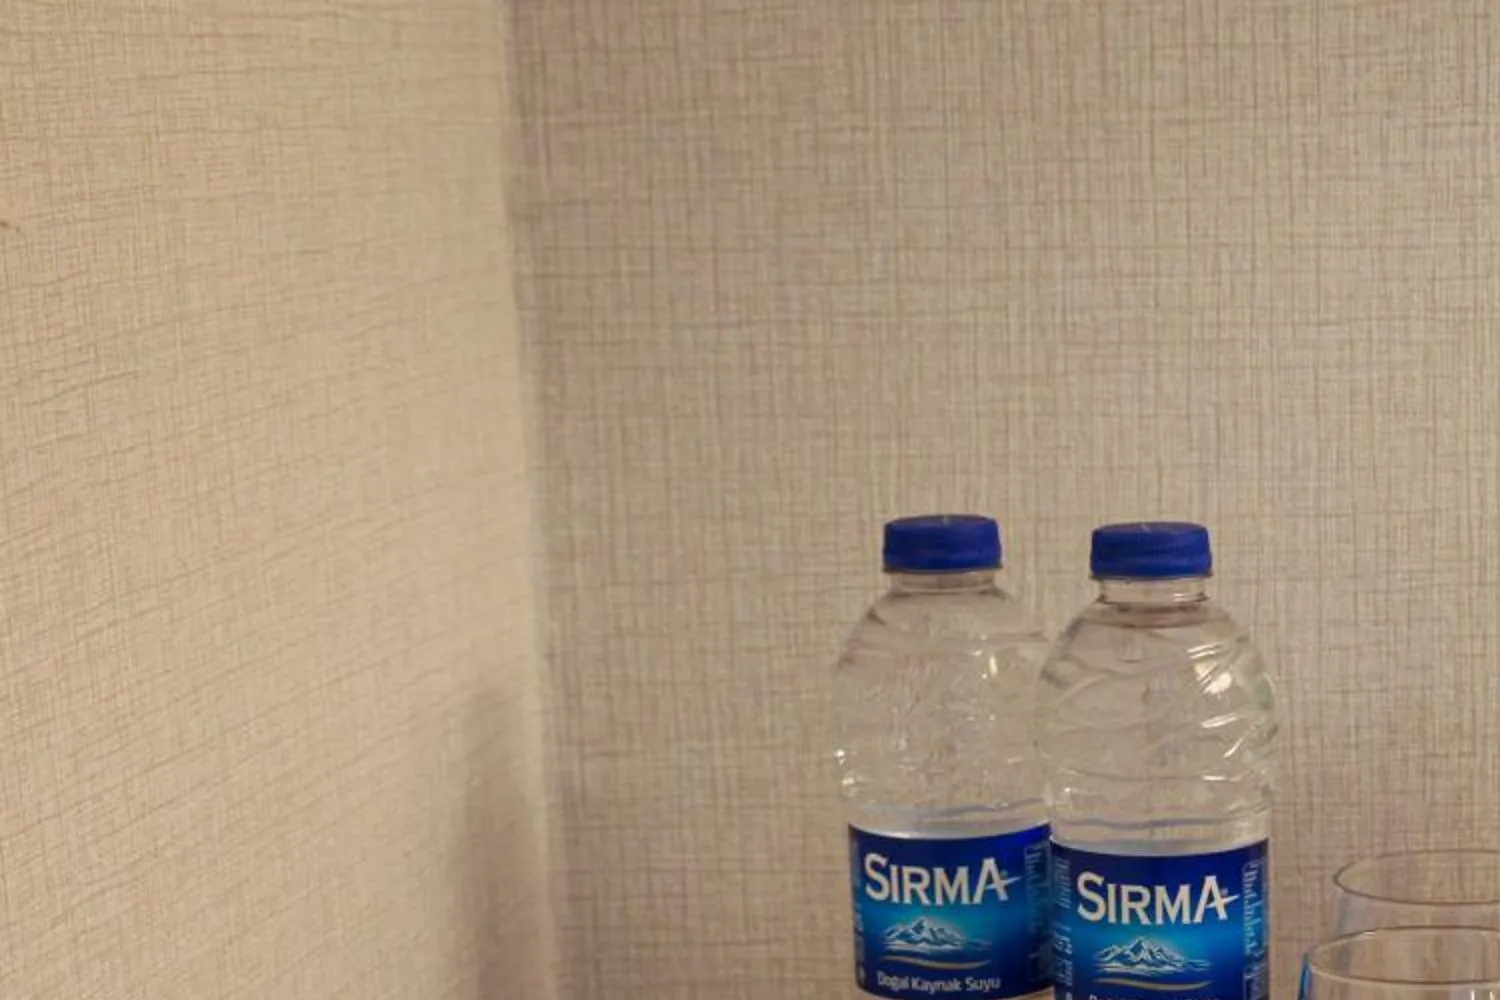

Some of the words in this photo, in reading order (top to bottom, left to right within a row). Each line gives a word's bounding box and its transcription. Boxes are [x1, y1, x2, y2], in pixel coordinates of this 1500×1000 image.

[864, 853, 1021, 906] SIRMA
[1077, 872, 1239, 925] SIRMA
[911, 975, 962, 995] Kaynak
[964, 975, 1001, 993] Suyu
